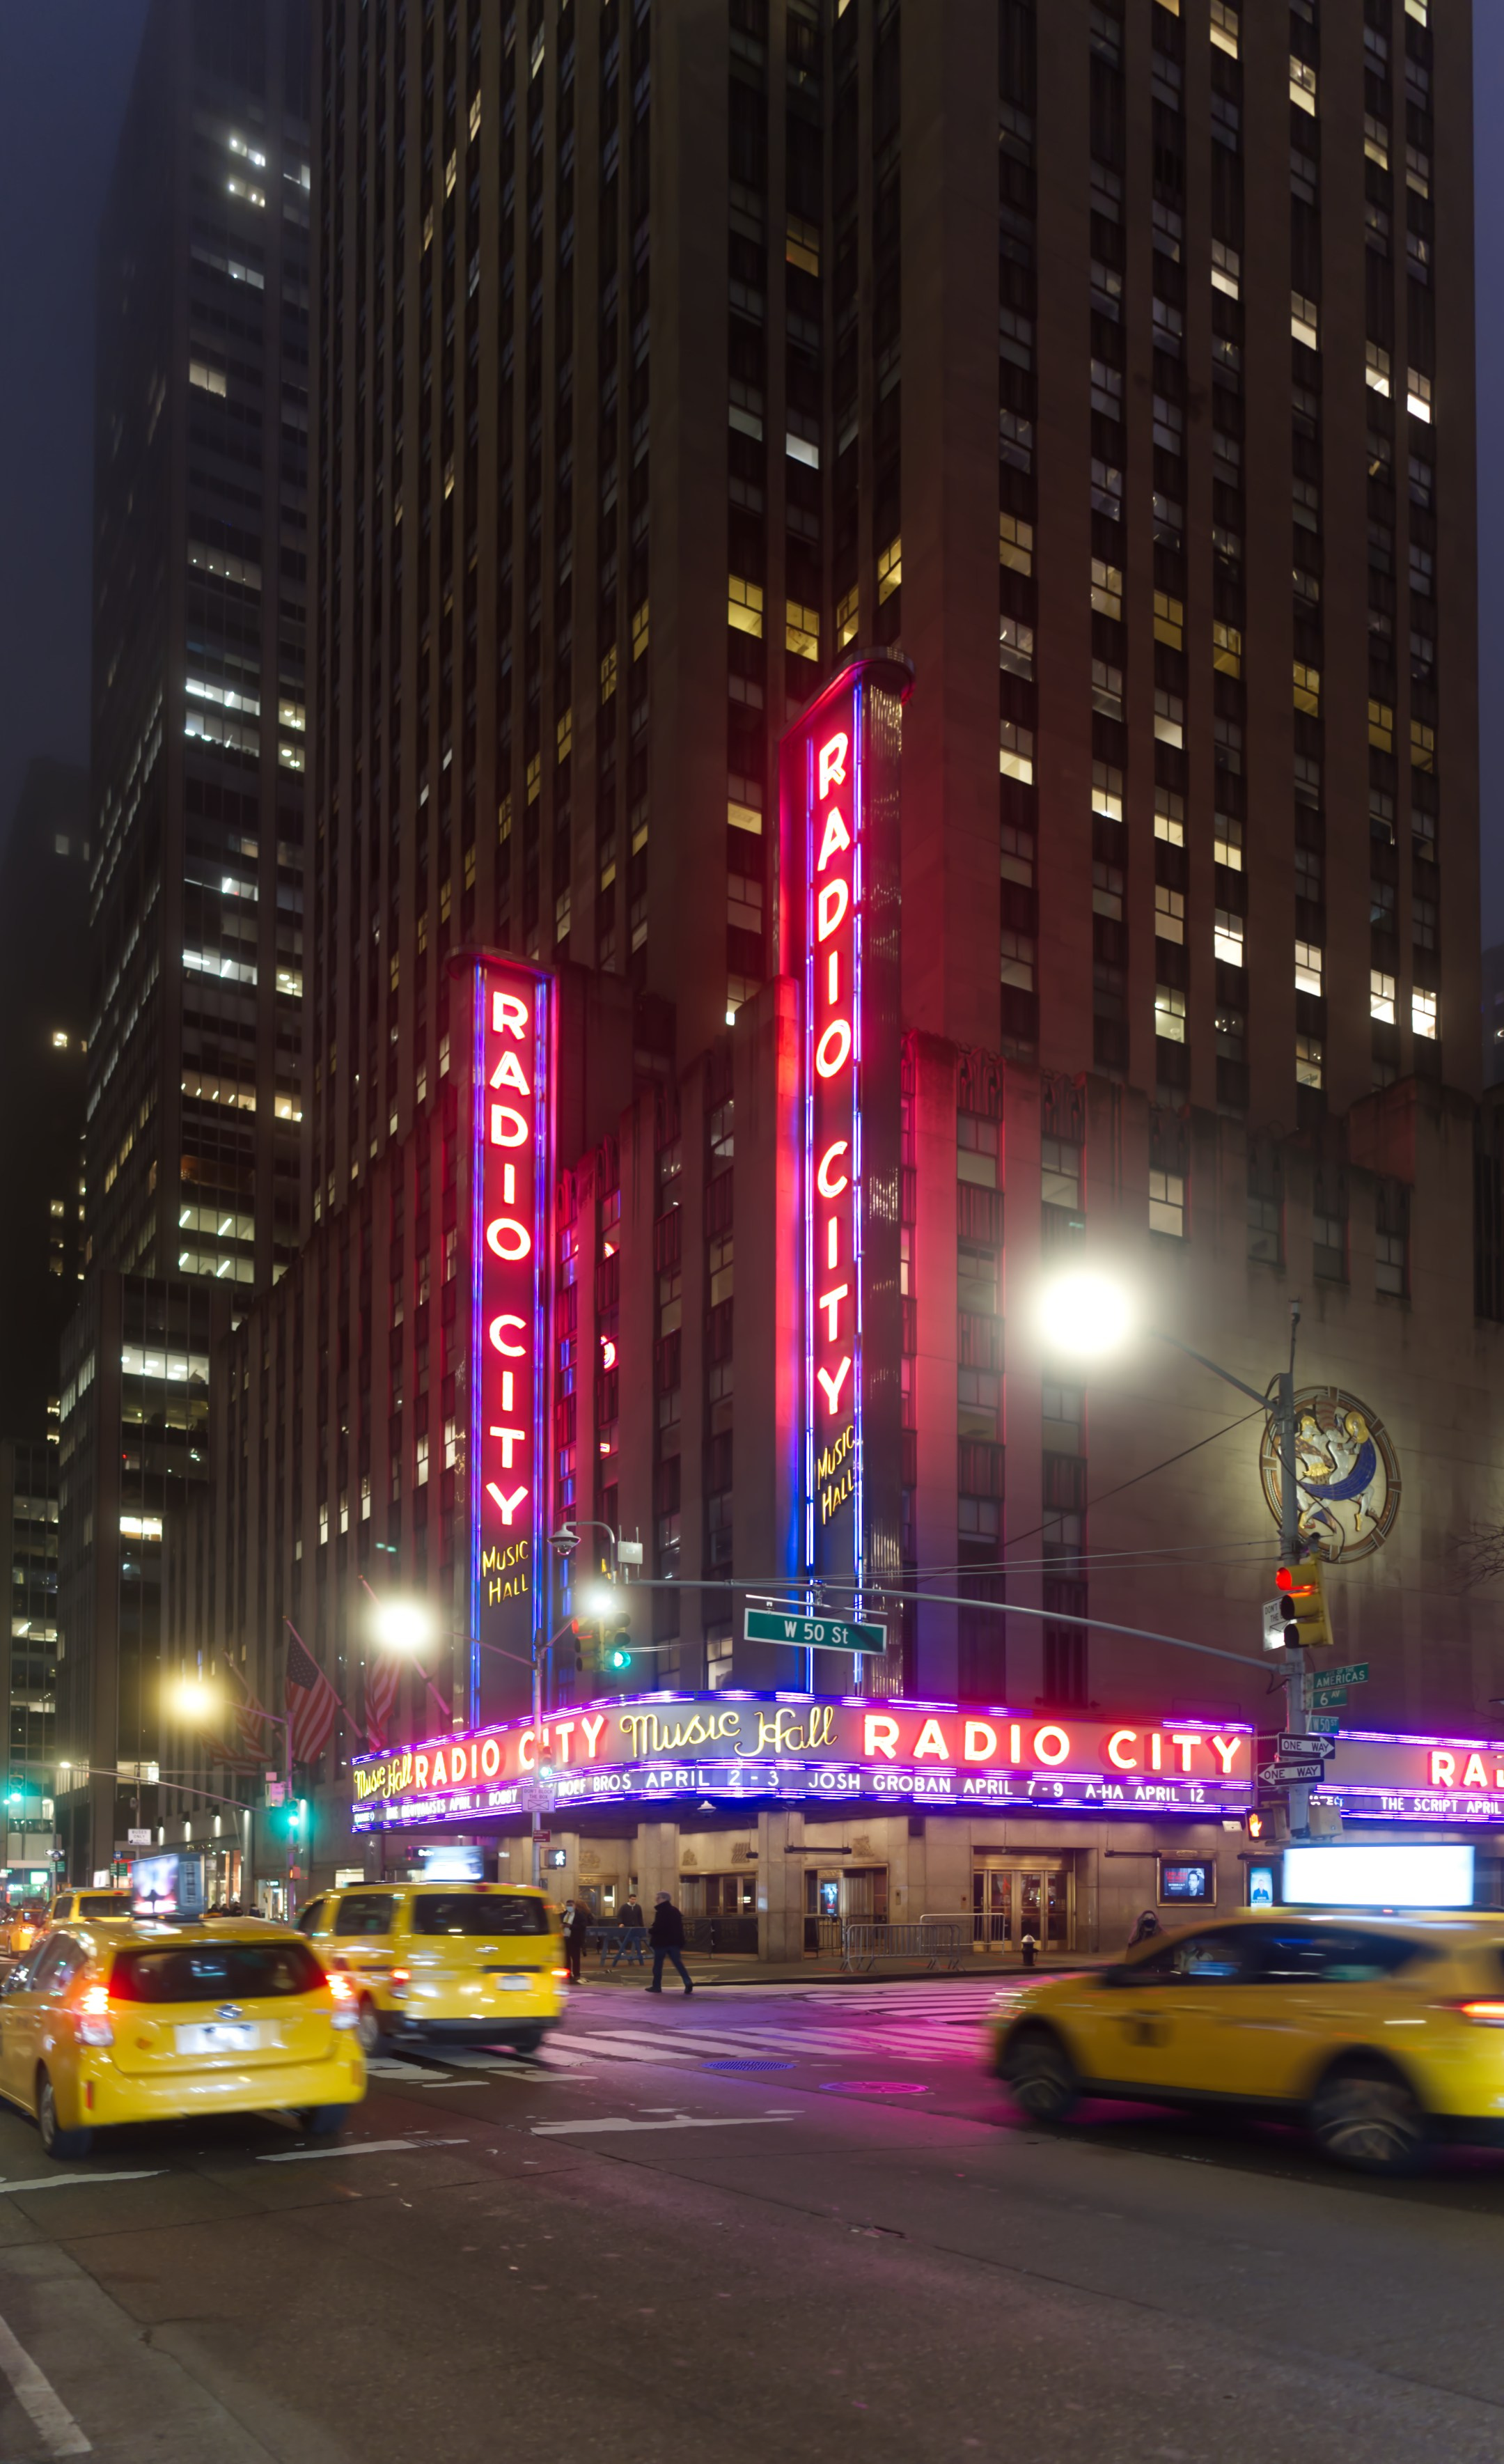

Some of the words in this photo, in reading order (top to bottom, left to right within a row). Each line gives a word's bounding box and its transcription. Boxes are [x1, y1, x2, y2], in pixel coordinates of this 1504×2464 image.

[815, 732, 852, 1078] RADIO
[486, 991, 531, 1261] RADIO
[816, 1140, 852, 1415] CITY
[485, 1314, 528, 1525] CITY
[817, 1425, 854, 1490] MUSIC
[822, 1469, 854, 1525] HALL
[483, 1540, 528, 1577] MUSIC
[489, 1573, 528, 1607] HALL
[784, 1620, 797, 1638] W
[804, 1623, 825, 1642] 50
[831, 1626, 849, 1644] St
[1270, 1613, 1279, 1622] THE
[1316, 1671, 1365, 1687] AMERICAS
[1320, 1692, 1329, 1706] 6
[619, 1711, 741, 1758] Music
[734, 1706, 838, 1757] Hall
[1313, 1718, 1319, 1731] W
[1320, 1718, 1330, 1732] 50
[863, 1714, 1071, 1766] RADIO
[1107, 1730, 1241, 1774] CITY
[1283, 1740, 1302, 1750] ONE
[1311, 1742, 1329, 1752] WAY
[415, 1738, 500, 1789] RADIO
[645, 1770, 710, 1788] APRIL
[1264, 1770, 1285, 1779] ONE
[1297, 1766, 1318, 1777] WAY
[593, 1773, 632, 1792] BROS
[808, 1772, 860, 1791] JOSH
[873, 1774, 951, 1793] GROBAN
[963, 1777, 1013, 1797] APRIL
[1085, 1783, 1124, 1800] A-HA
[1135, 1785, 1180, 1802] APRIL
[1189, 1787, 1205, 1803] 12
[1381, 1796, 1404, 1811] THE
[1413, 1798, 1459, 1813] SCRIPT
[1467, 1800, 1502, 1814] APRIL
